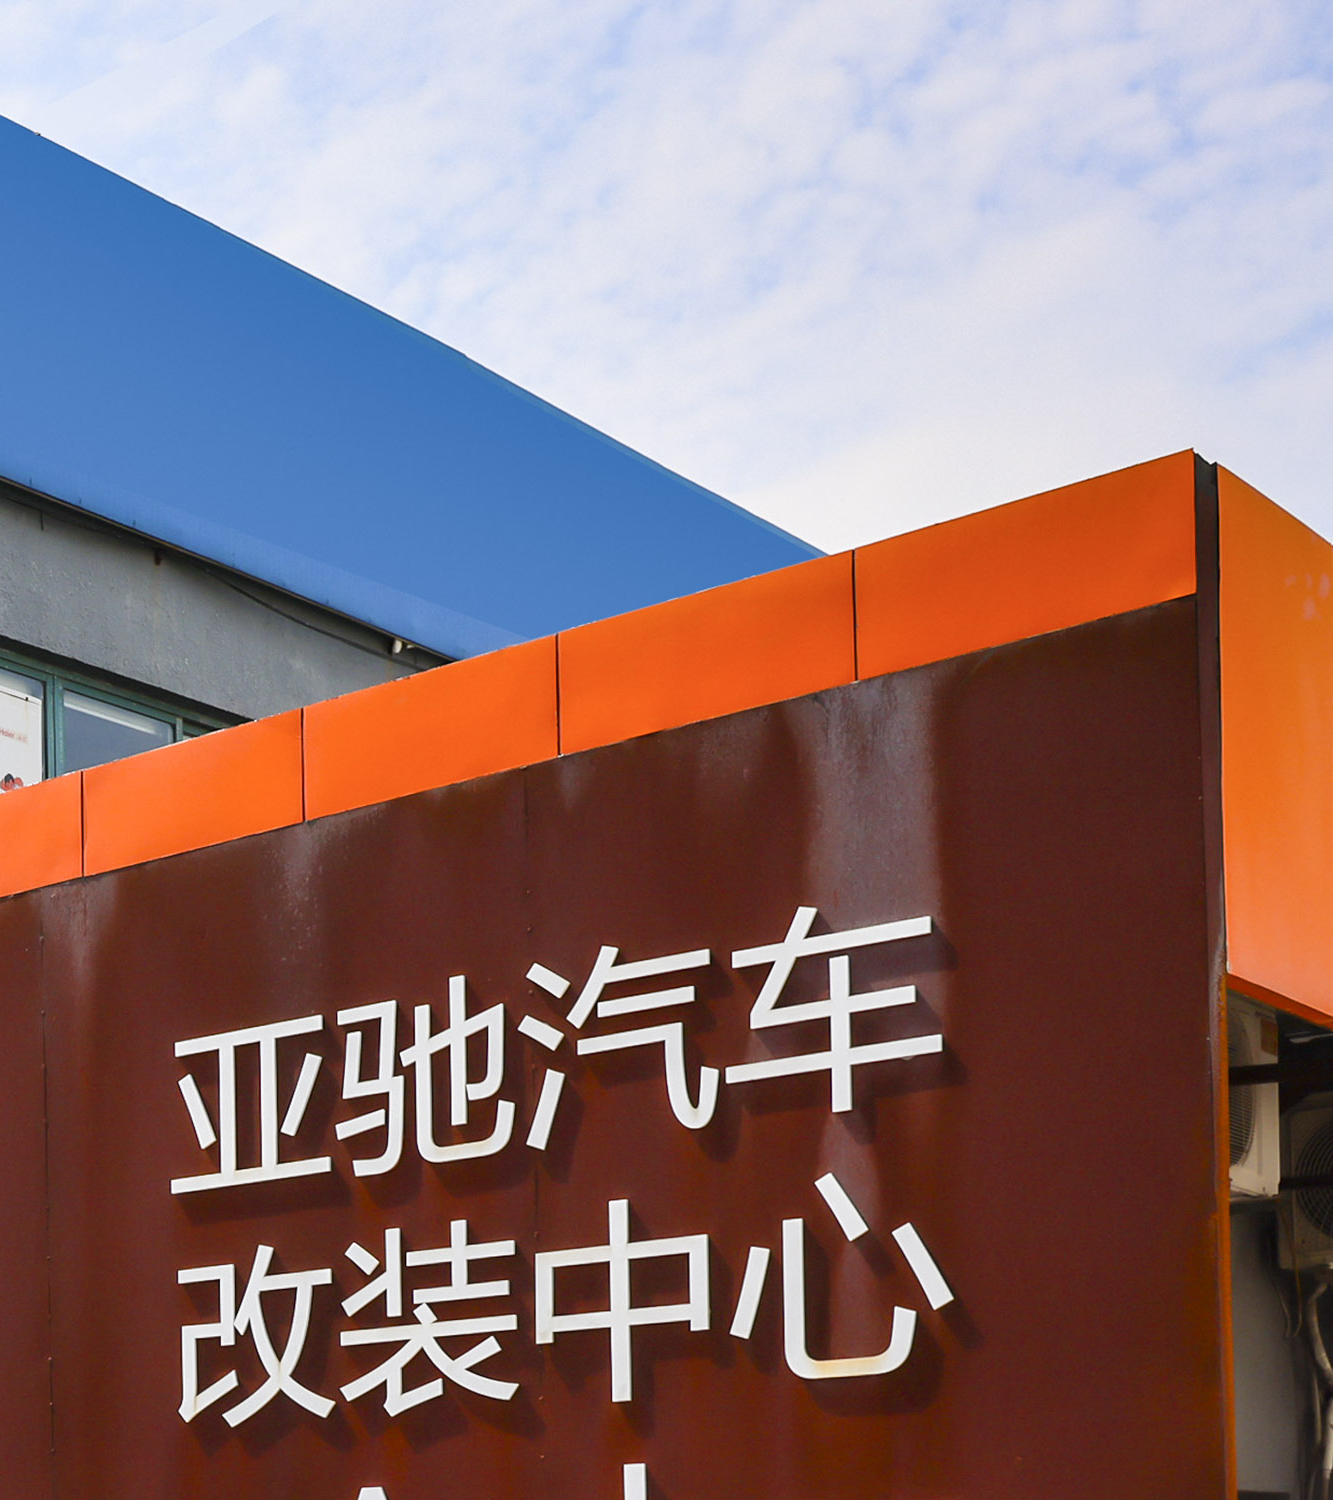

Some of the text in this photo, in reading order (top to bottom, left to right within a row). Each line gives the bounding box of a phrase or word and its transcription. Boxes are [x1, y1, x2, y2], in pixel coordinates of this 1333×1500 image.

[170, 905, 943, 1195] 亚驰汽车
[177, 1172, 955, 1428] 改装中心
